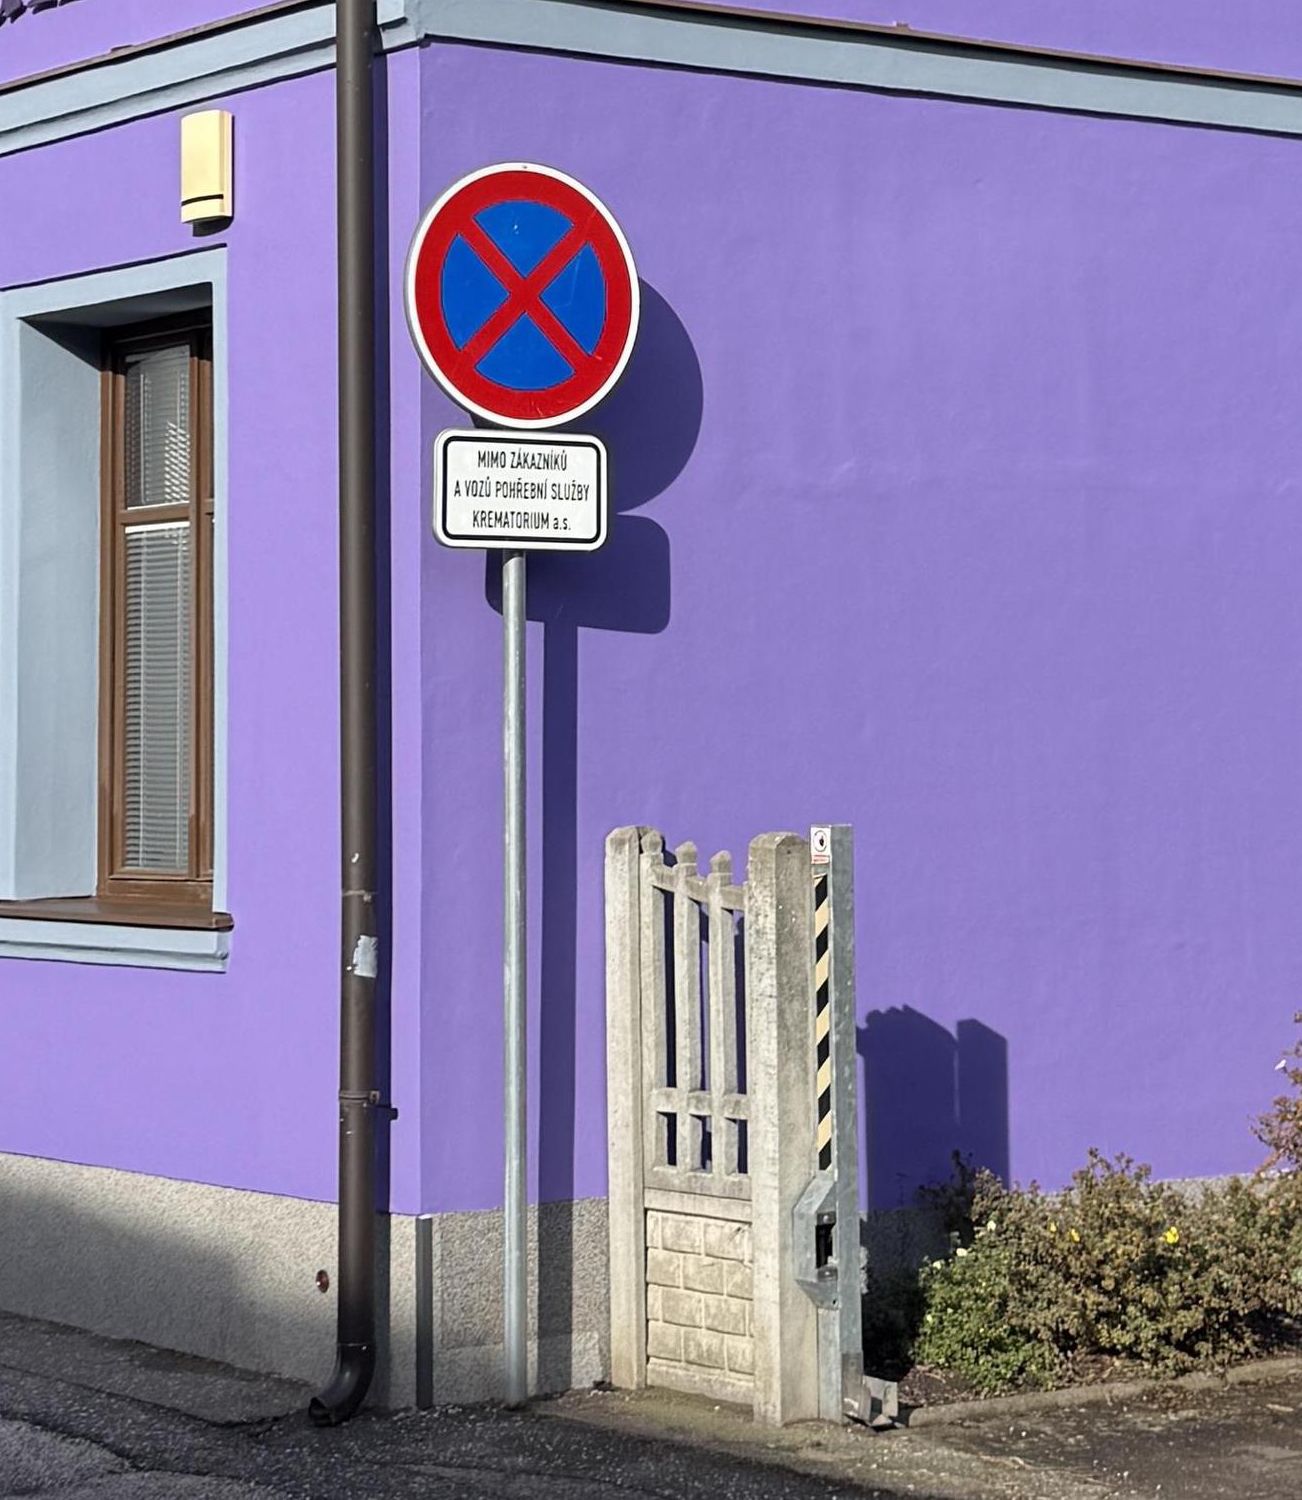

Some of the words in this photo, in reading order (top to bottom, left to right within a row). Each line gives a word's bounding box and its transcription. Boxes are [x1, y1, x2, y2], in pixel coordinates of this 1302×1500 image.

[477, 450, 507, 469] MIMO
[510, 448, 568, 472] ZÁKAZNÍKŮ
[454, 480, 461, 497] A
[465, 476, 492, 498] VOZŮ
[495, 477, 548, 500] POHŘEBNÍ
[551, 479, 590, 502] SLUŽBY
[472, 510, 549, 530] KREMATORIUM
[553, 517, 572, 531] a.s.
